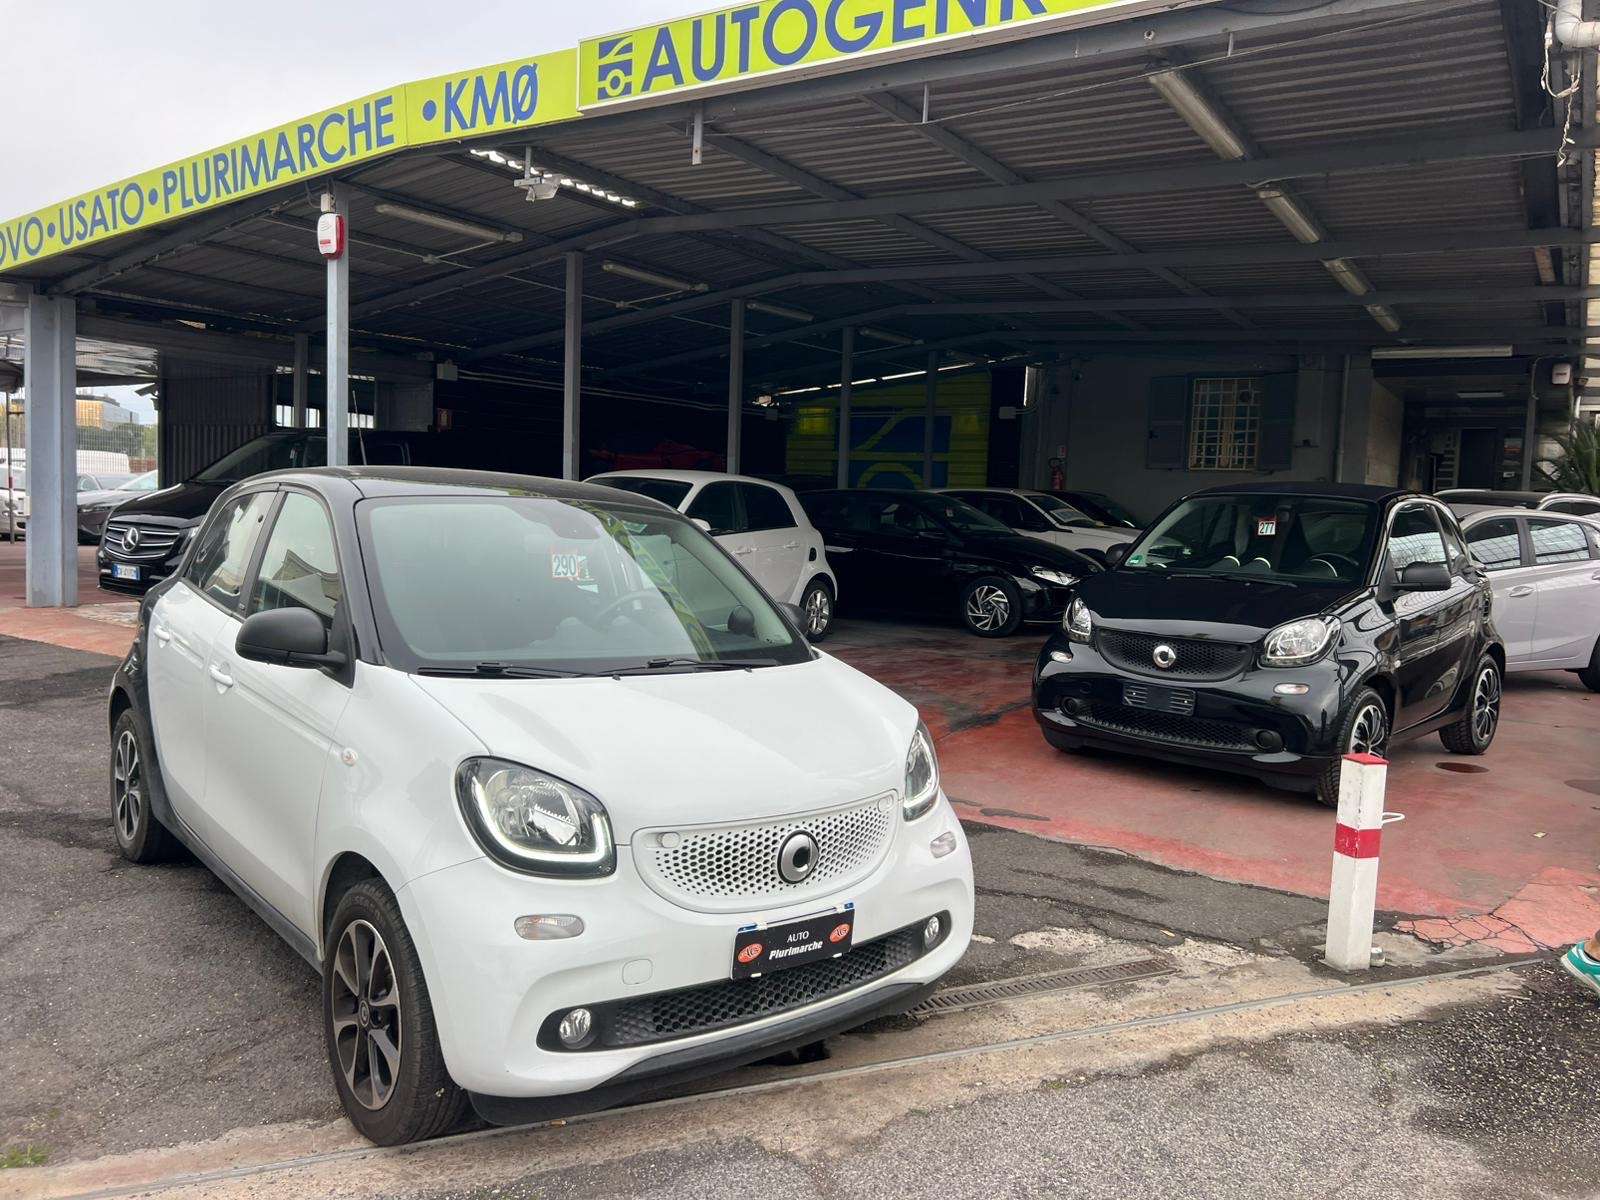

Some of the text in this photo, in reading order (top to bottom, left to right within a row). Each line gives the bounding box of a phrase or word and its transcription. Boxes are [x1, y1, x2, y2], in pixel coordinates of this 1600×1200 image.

[59, 182, 144, 245] USATO
[162, 95, 395, 214] PLURIMARCHE
[1259, 521, 1275, 534] 277
[553, 555, 577, 576] 290
[787, 931, 809, 943] AUTO
[768, 940, 823, 960] Plurimarche
